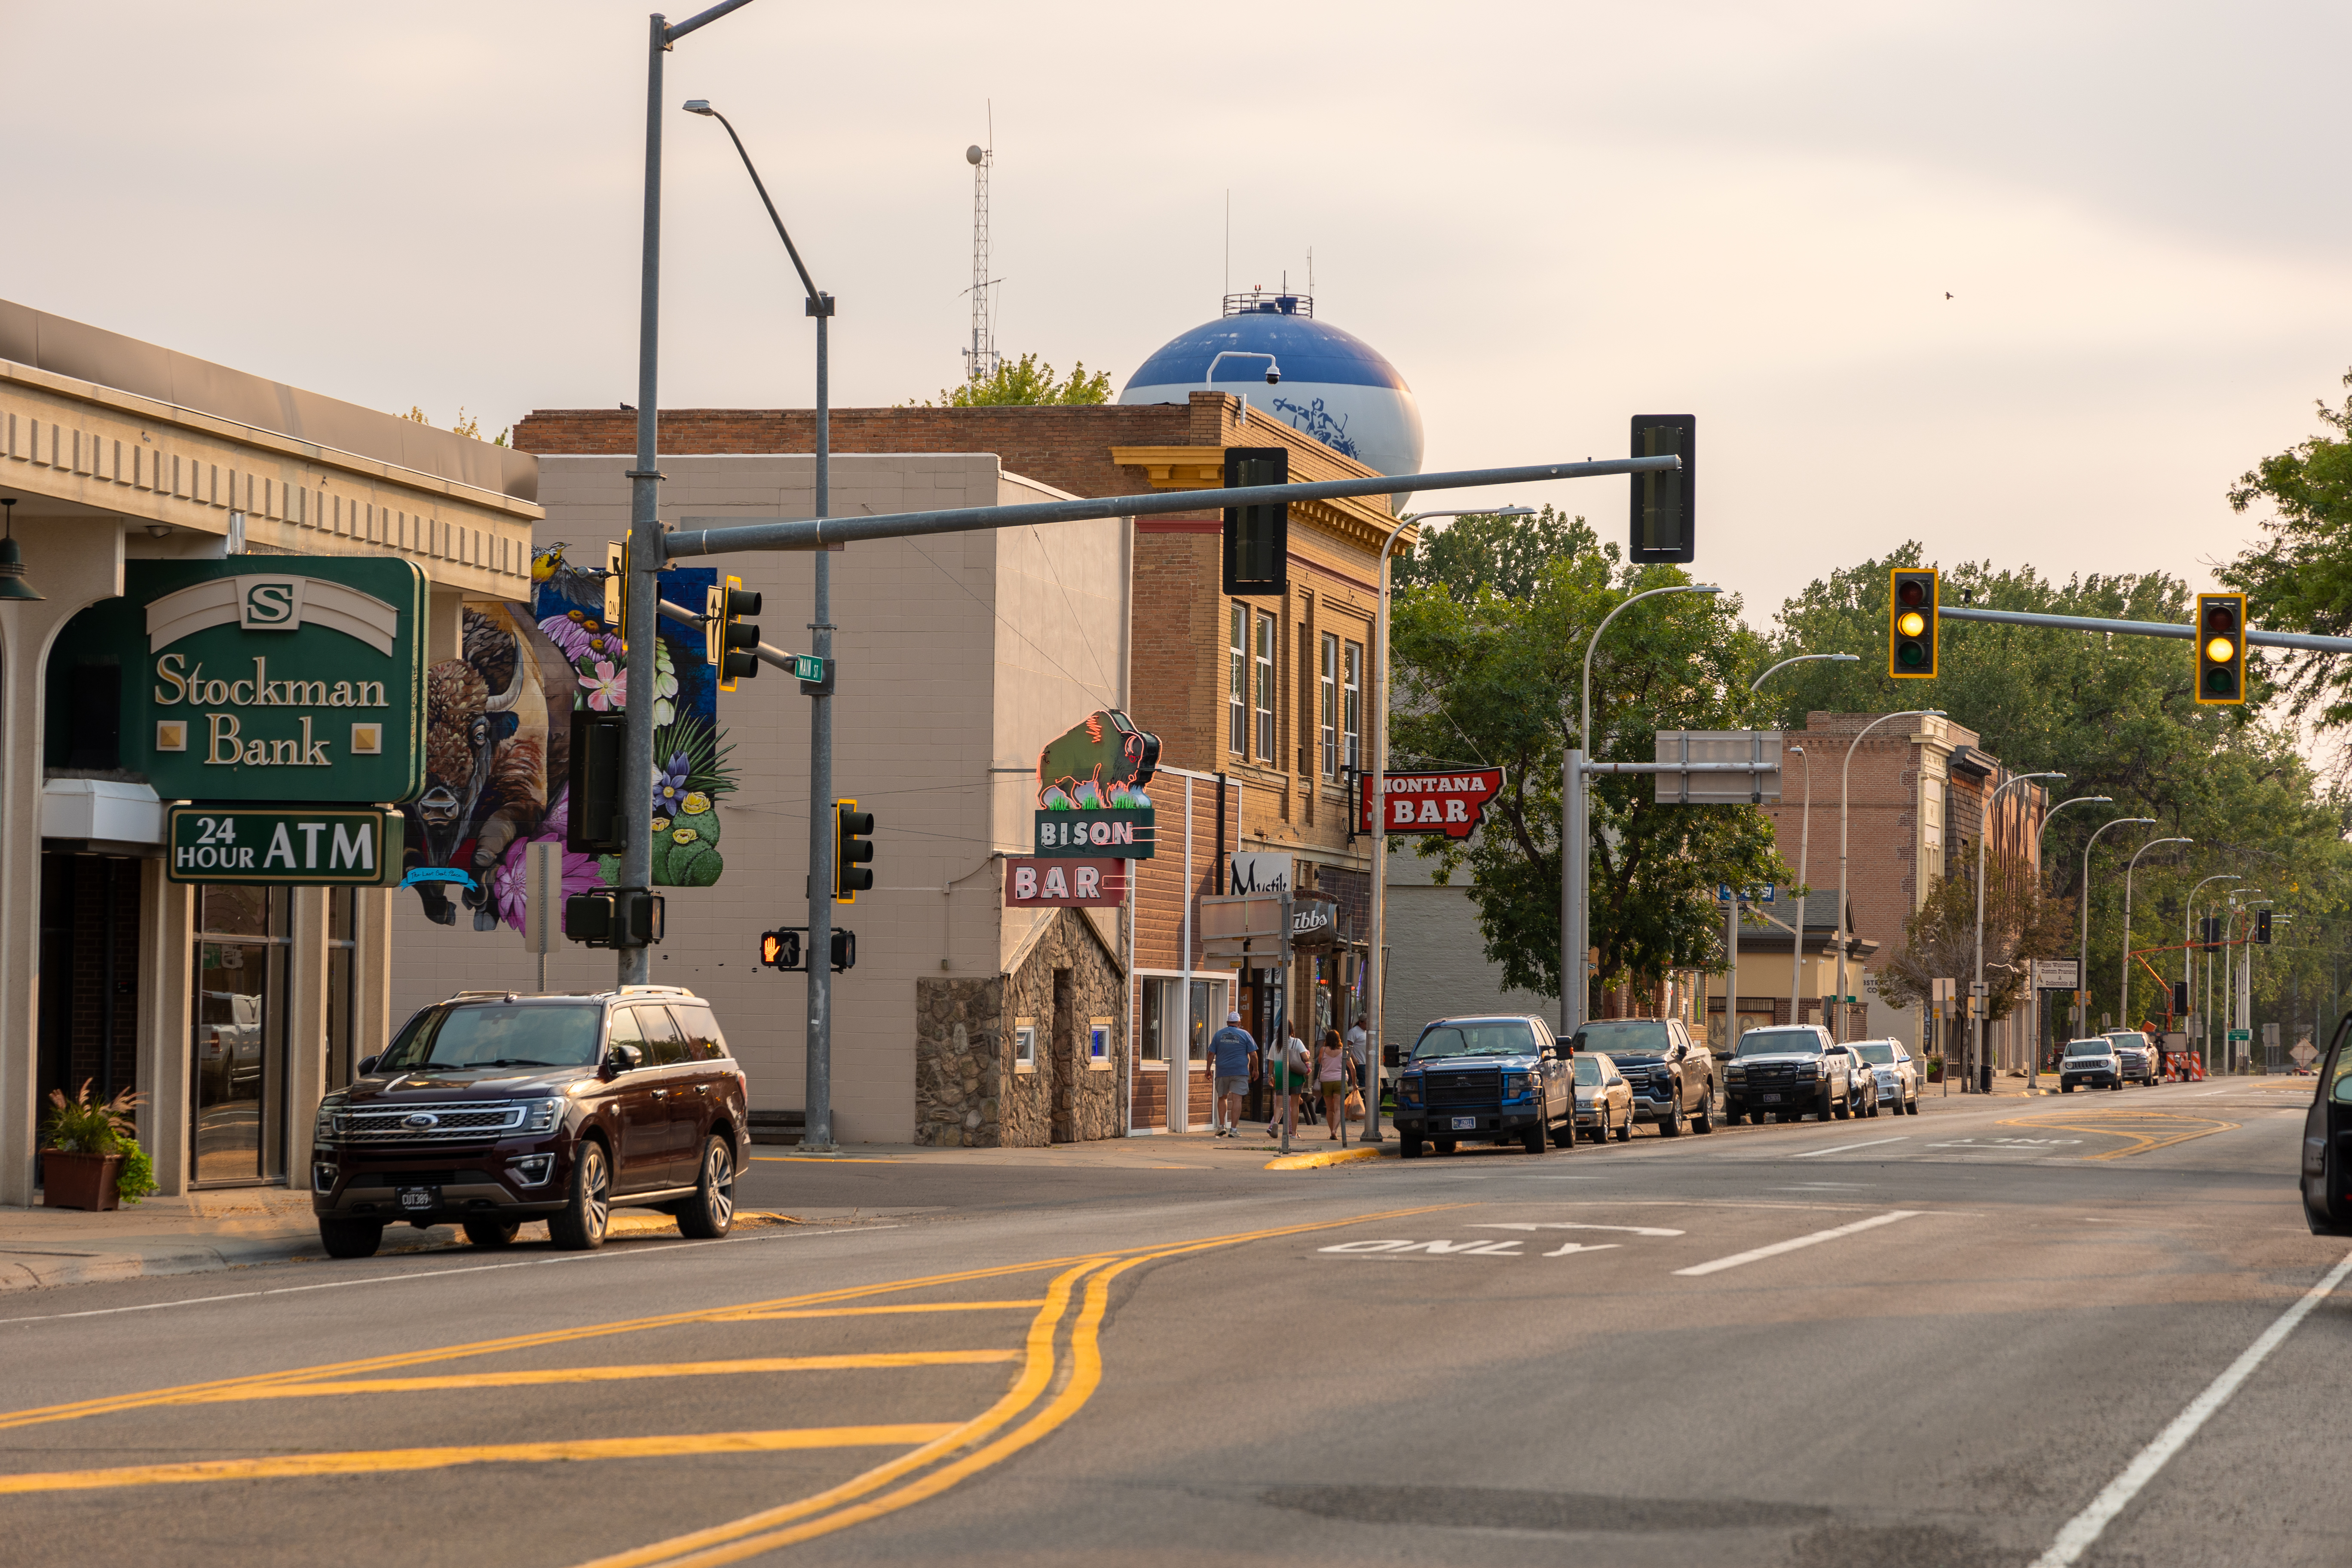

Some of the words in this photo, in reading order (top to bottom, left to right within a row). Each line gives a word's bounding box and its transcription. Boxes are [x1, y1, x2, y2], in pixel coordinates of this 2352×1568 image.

[608, 600, 619, 616] ONL
[155, 654, 389, 707] Stockman
[799, 658, 812, 677] MAIN
[813, 665, 818, 678] ST
[204, 714, 332, 766] Bank
[1393, 799, 1468, 824] BAR
[196, 818, 236, 844] 24
[1041, 821, 1133, 846] BISON
[177, 847, 255, 868] HOUR
[263, 822, 374, 869] ATM
[1015, 866, 1101, 900] BAR
[1315, 891, 1333, 900] BAR
[1293, 910, 1328, 929] ubbs
[1318, 1240, 1623, 1257] ONLY
